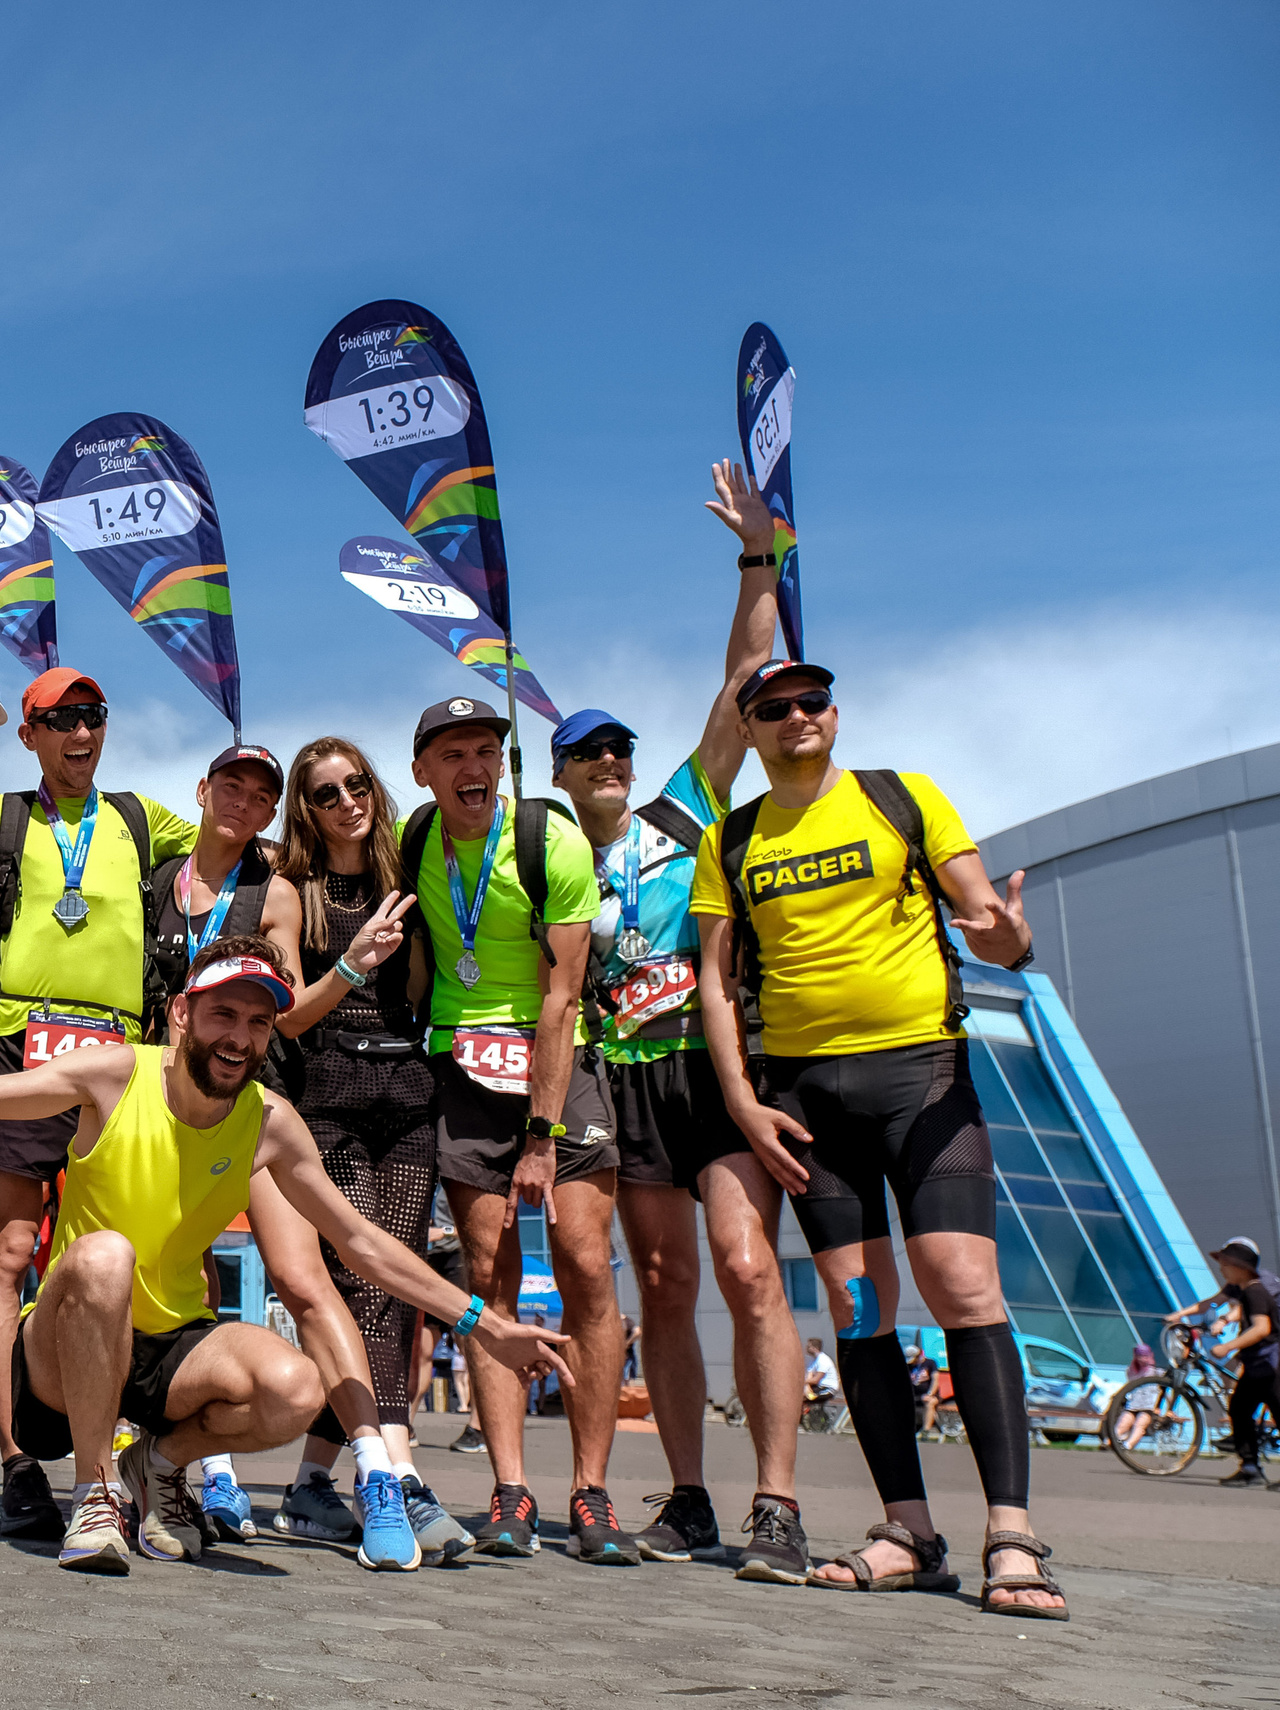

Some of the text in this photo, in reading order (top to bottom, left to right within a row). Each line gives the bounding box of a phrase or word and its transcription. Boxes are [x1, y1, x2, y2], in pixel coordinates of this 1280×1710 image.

[339, 329, 391, 352] Быстрее
[364, 349, 404, 370] Ветра
[358, 385, 435, 434] 1:39
[75, 438, 127, 458] Быстрее
[373, 428, 436, 448] 4:42 мин/км
[98, 455, 137, 474] Ветра
[88, 487, 166, 530] 1:49
[102, 527, 163, 542] 5:10 мин/км
[387, 582, 446, 607] 2:19
[753, 850, 864, 894] PACER
[29, 1030, 121, 1062] 14
[458, 1040, 535, 1074] 145
